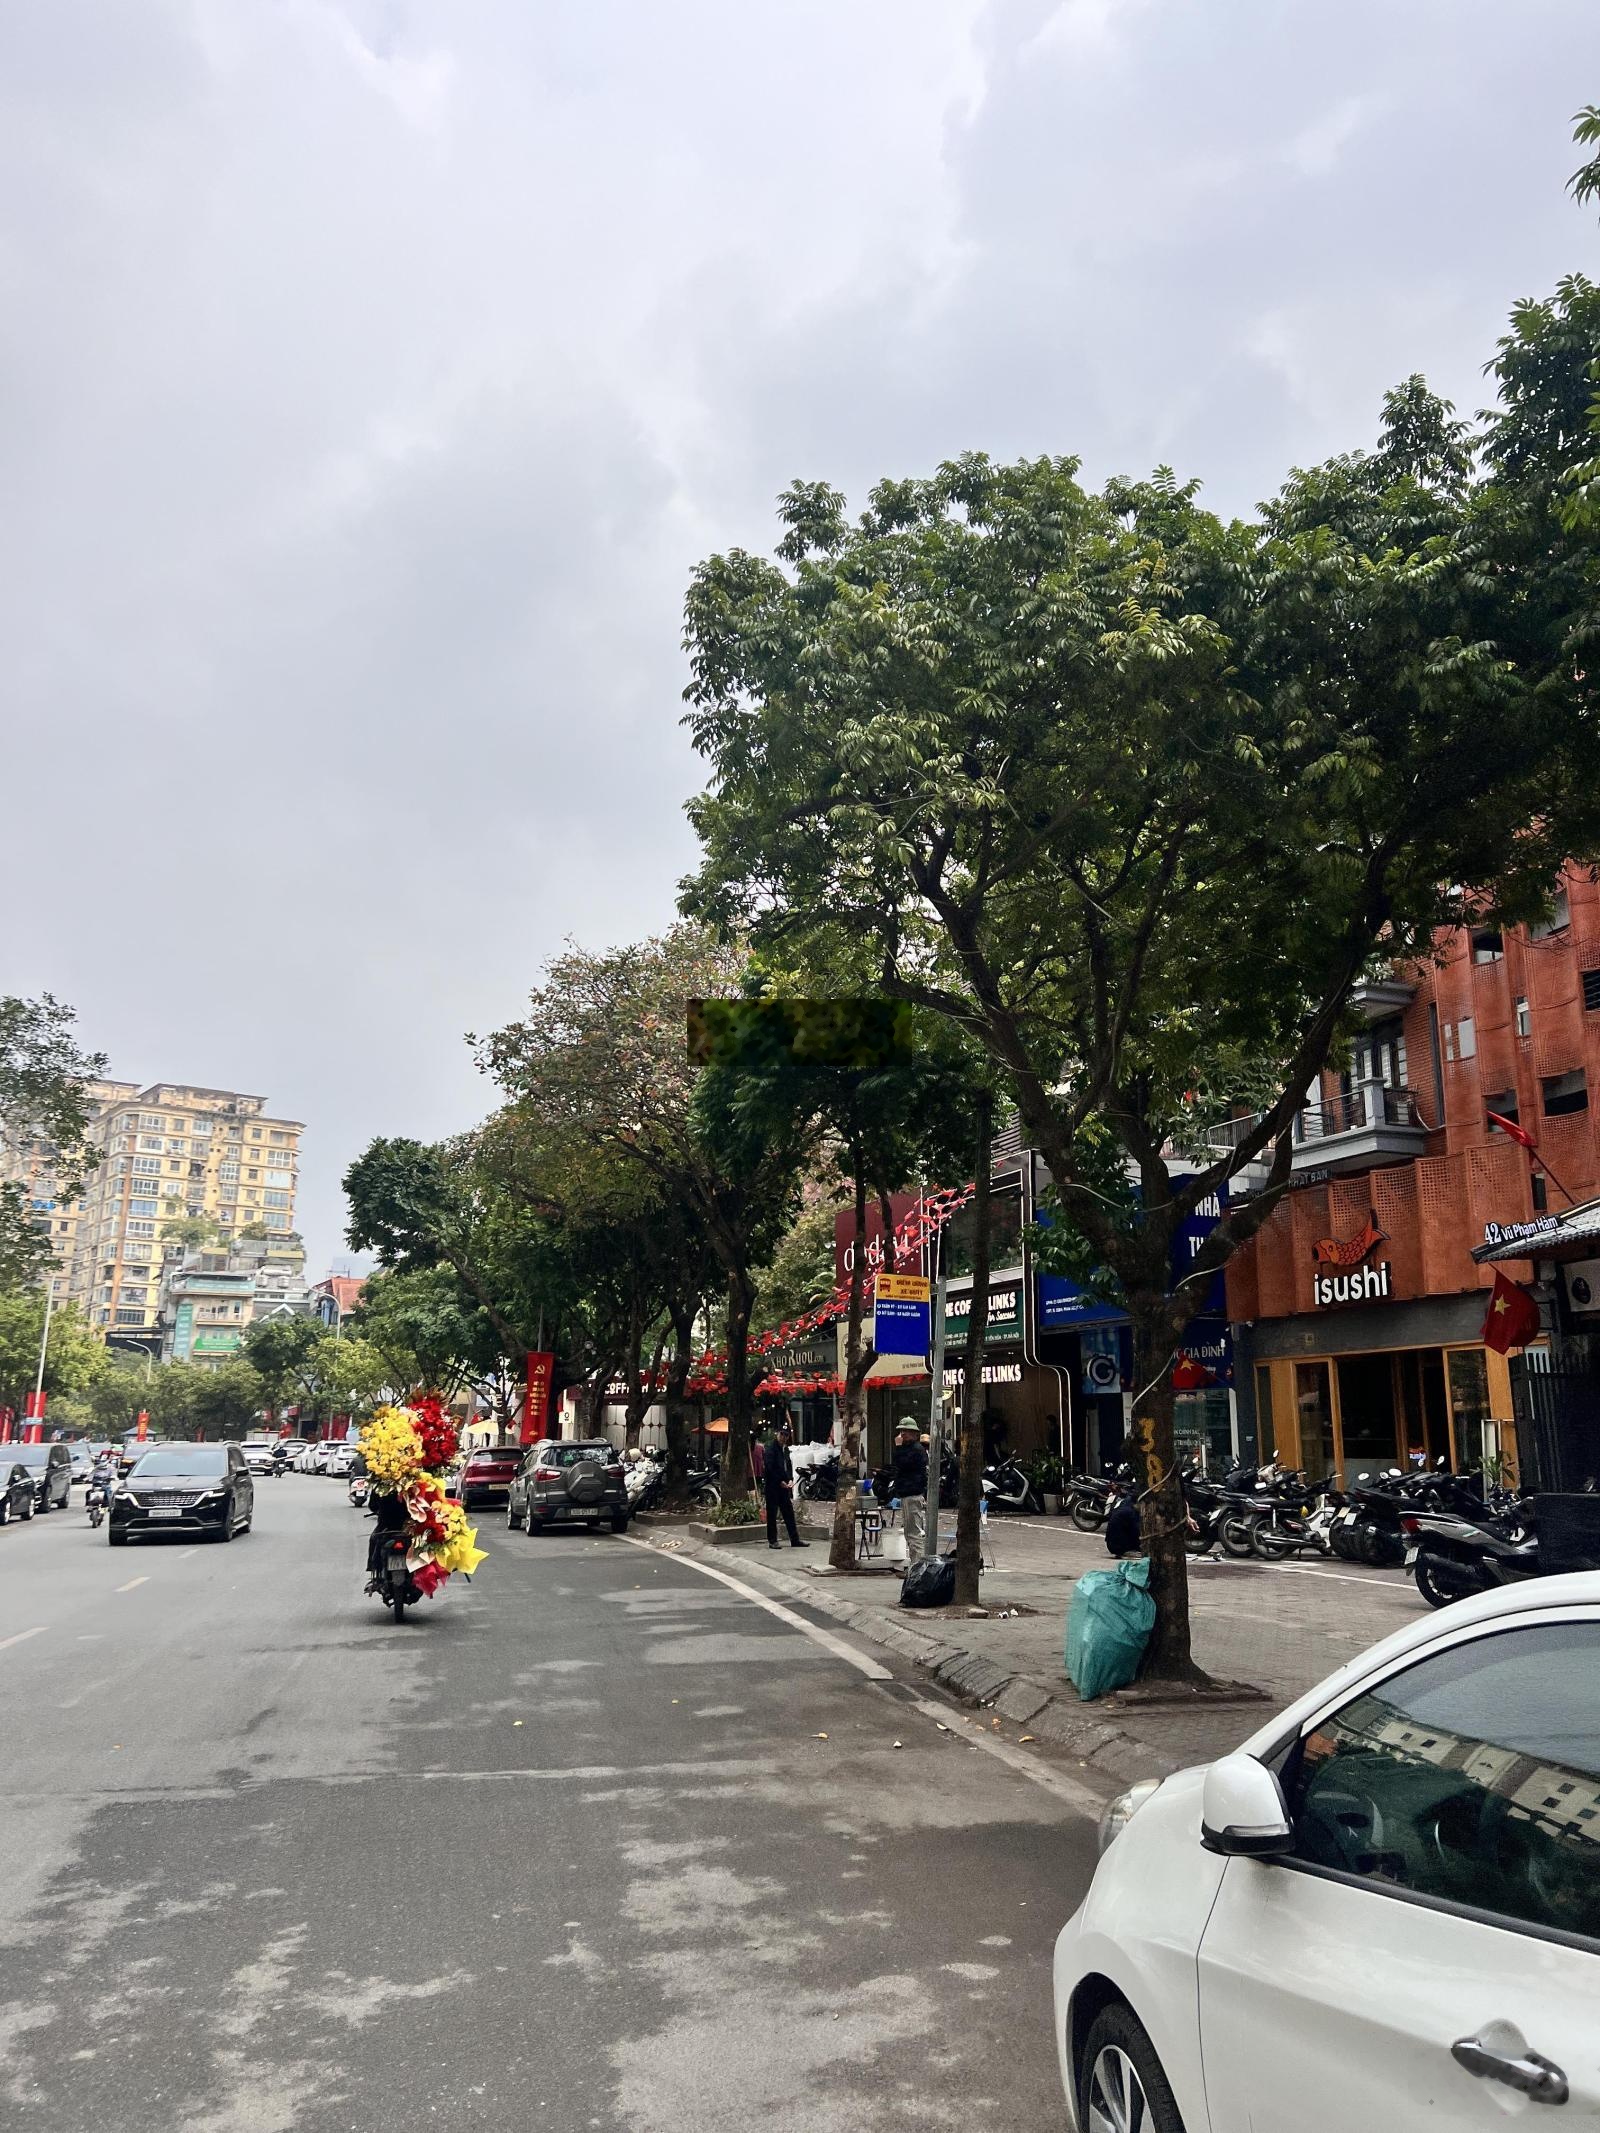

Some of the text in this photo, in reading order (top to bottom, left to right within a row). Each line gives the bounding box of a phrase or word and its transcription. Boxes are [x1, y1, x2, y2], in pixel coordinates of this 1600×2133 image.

[1485, 1215, 1558, 1245] 42 Vũ Phạm Hàm
[1314, 1261, 1388, 1305] isushi
[988, 1291, 1016, 1311] LINKS
[992, 1363, 1022, 1383] LINKS
